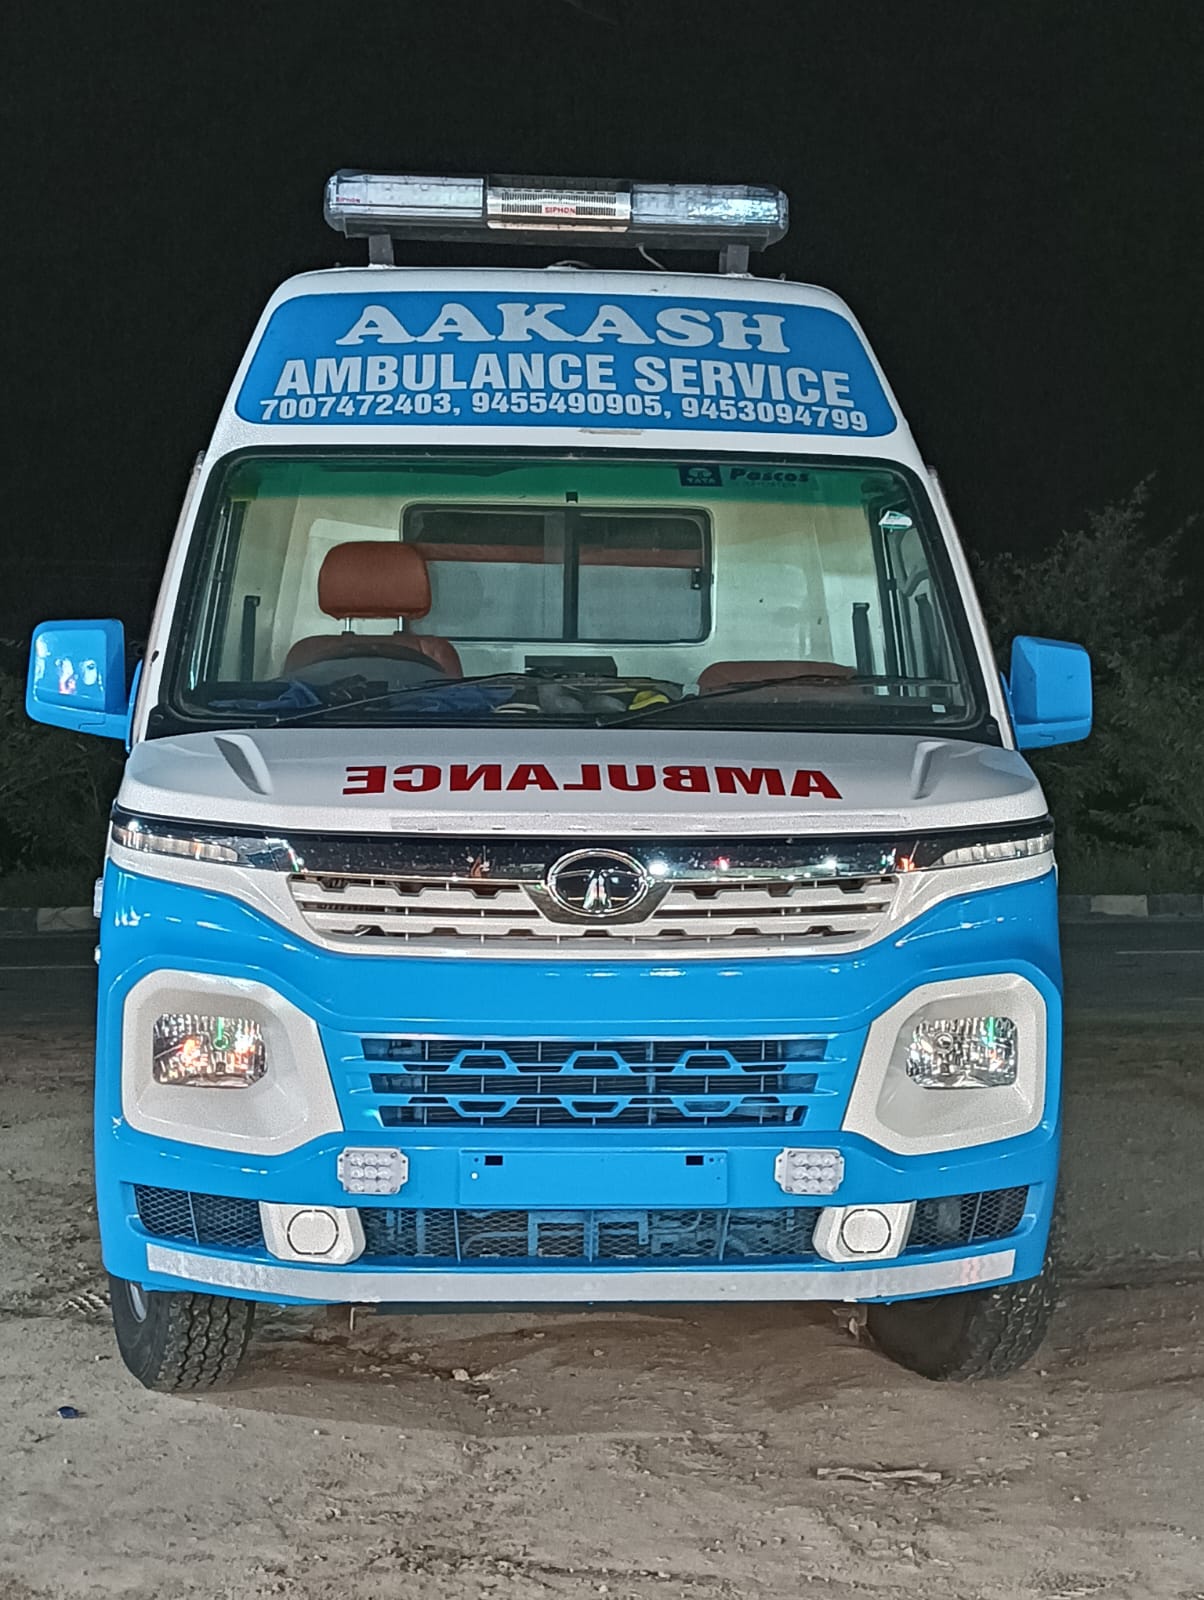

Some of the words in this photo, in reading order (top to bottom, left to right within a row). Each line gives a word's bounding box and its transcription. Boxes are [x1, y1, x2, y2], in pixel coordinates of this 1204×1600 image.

[545, 206, 576, 214] SIPHON
[336, 303, 790, 353] AAKASH
[275, 353, 617, 397] AMBULANCE
[635, 357, 855, 409] SERVICE
[260, 394, 461, 420] 7007472403,
[472, 393, 671, 419] 9455490905,
[682, 396, 868, 431] 9453094799
